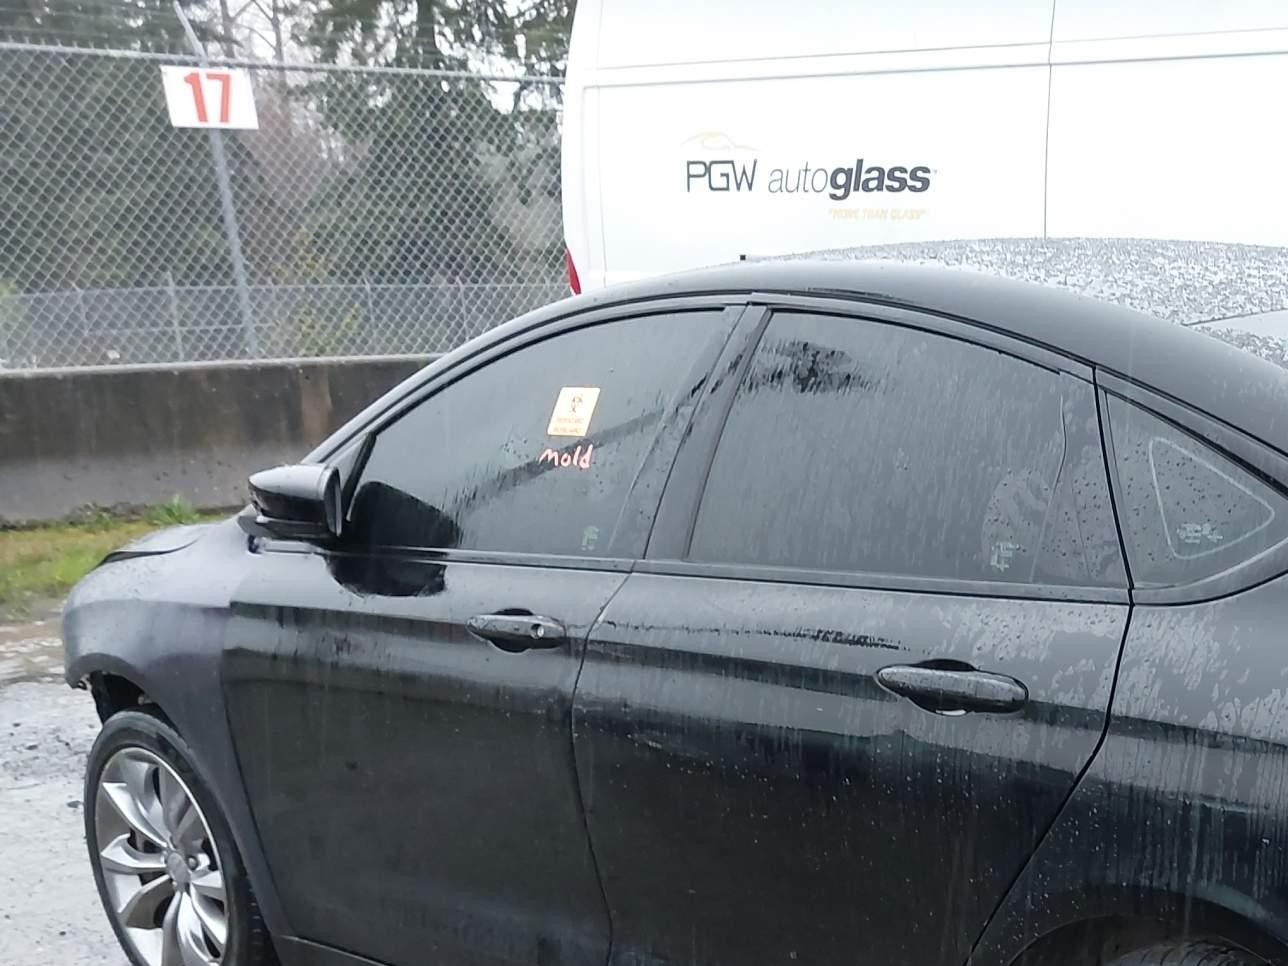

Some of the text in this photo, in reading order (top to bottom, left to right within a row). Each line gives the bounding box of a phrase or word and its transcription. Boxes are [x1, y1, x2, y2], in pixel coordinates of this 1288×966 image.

[184, 72, 231, 123] 17
[685, 158, 932, 201] PGW autoglass
